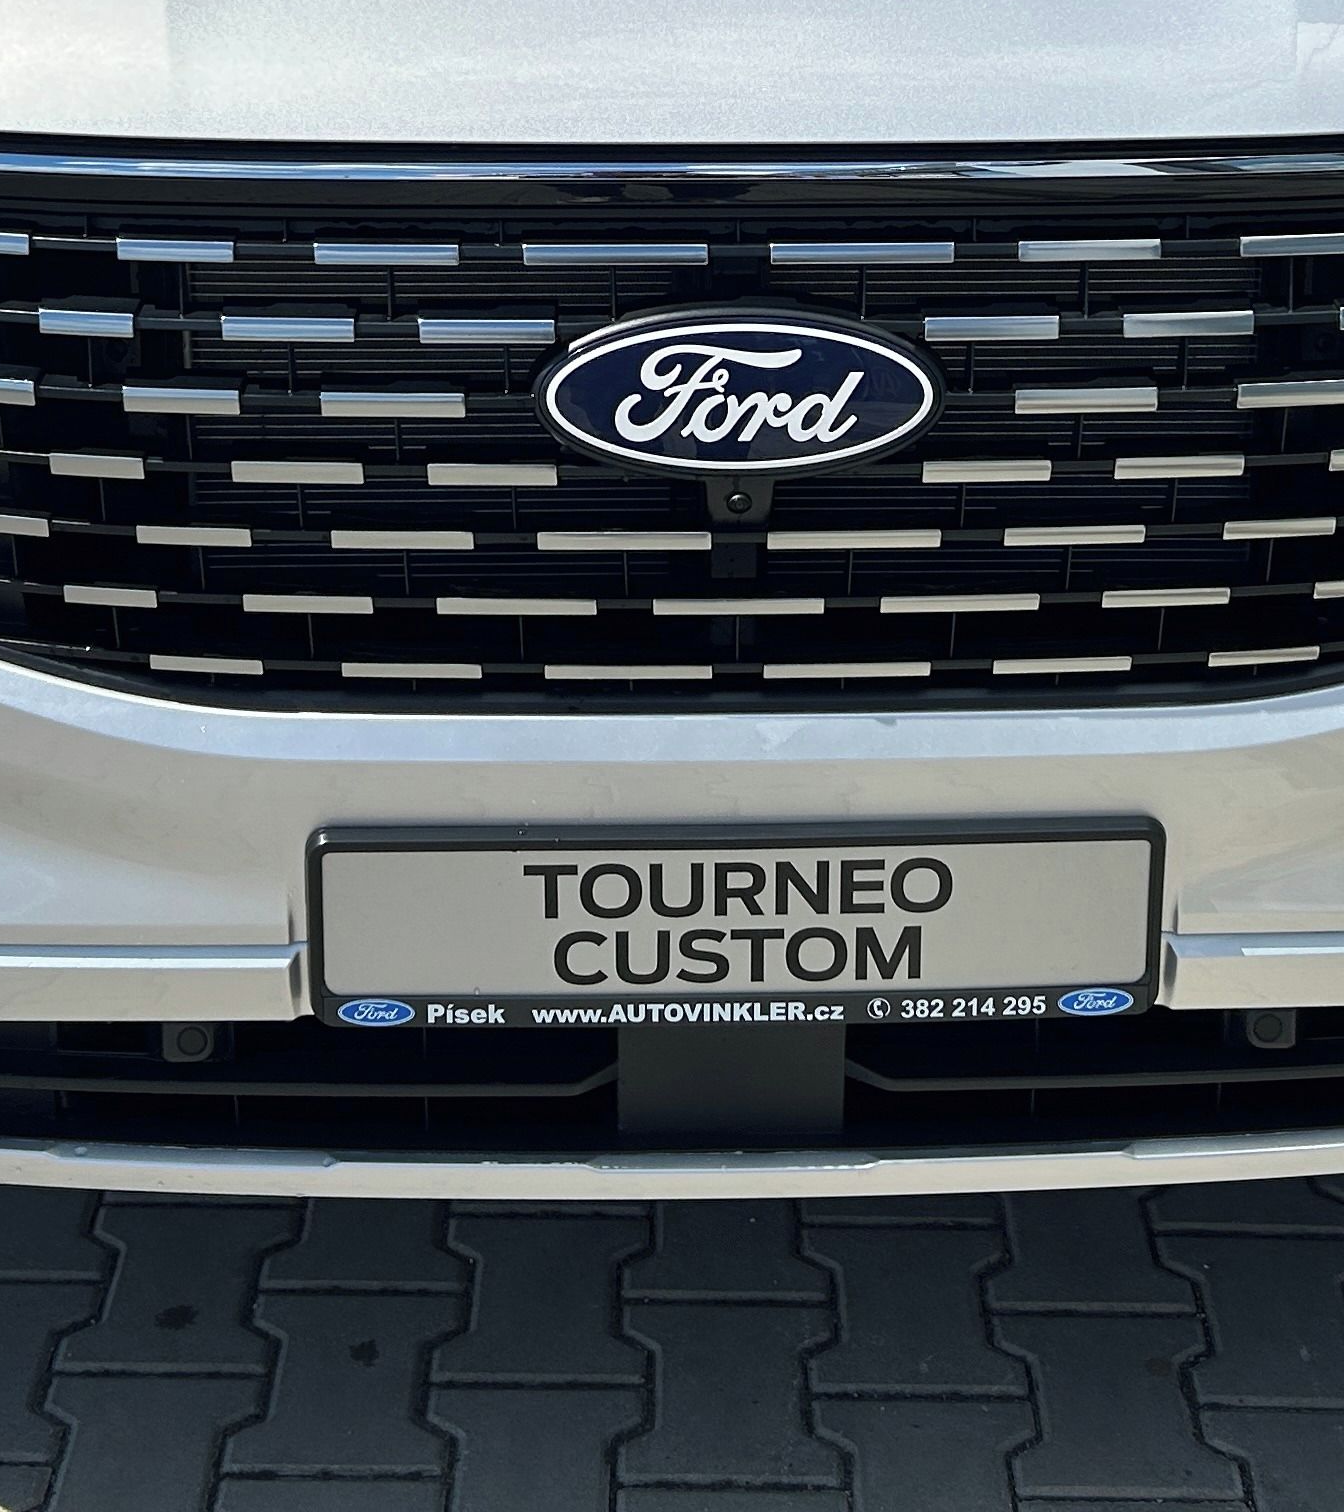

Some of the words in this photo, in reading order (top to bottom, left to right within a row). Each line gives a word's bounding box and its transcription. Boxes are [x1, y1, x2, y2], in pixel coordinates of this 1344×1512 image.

[614, 344, 865, 443] Ford
[522, 857, 954, 919] TOURNEO
[553, 925, 923, 986] CUSTOM
[353, 1003, 399, 1020] Ford
[427, 1003, 506, 1024] Písek
[531, 1001, 844, 1024] www.AUTOVINKLER.cz
[900, 999, 944, 1019] 382
[951, 997, 996, 1017] 214
[1002, 995, 1047, 1016] 295
[1072, 993, 1117, 1011] Ford
